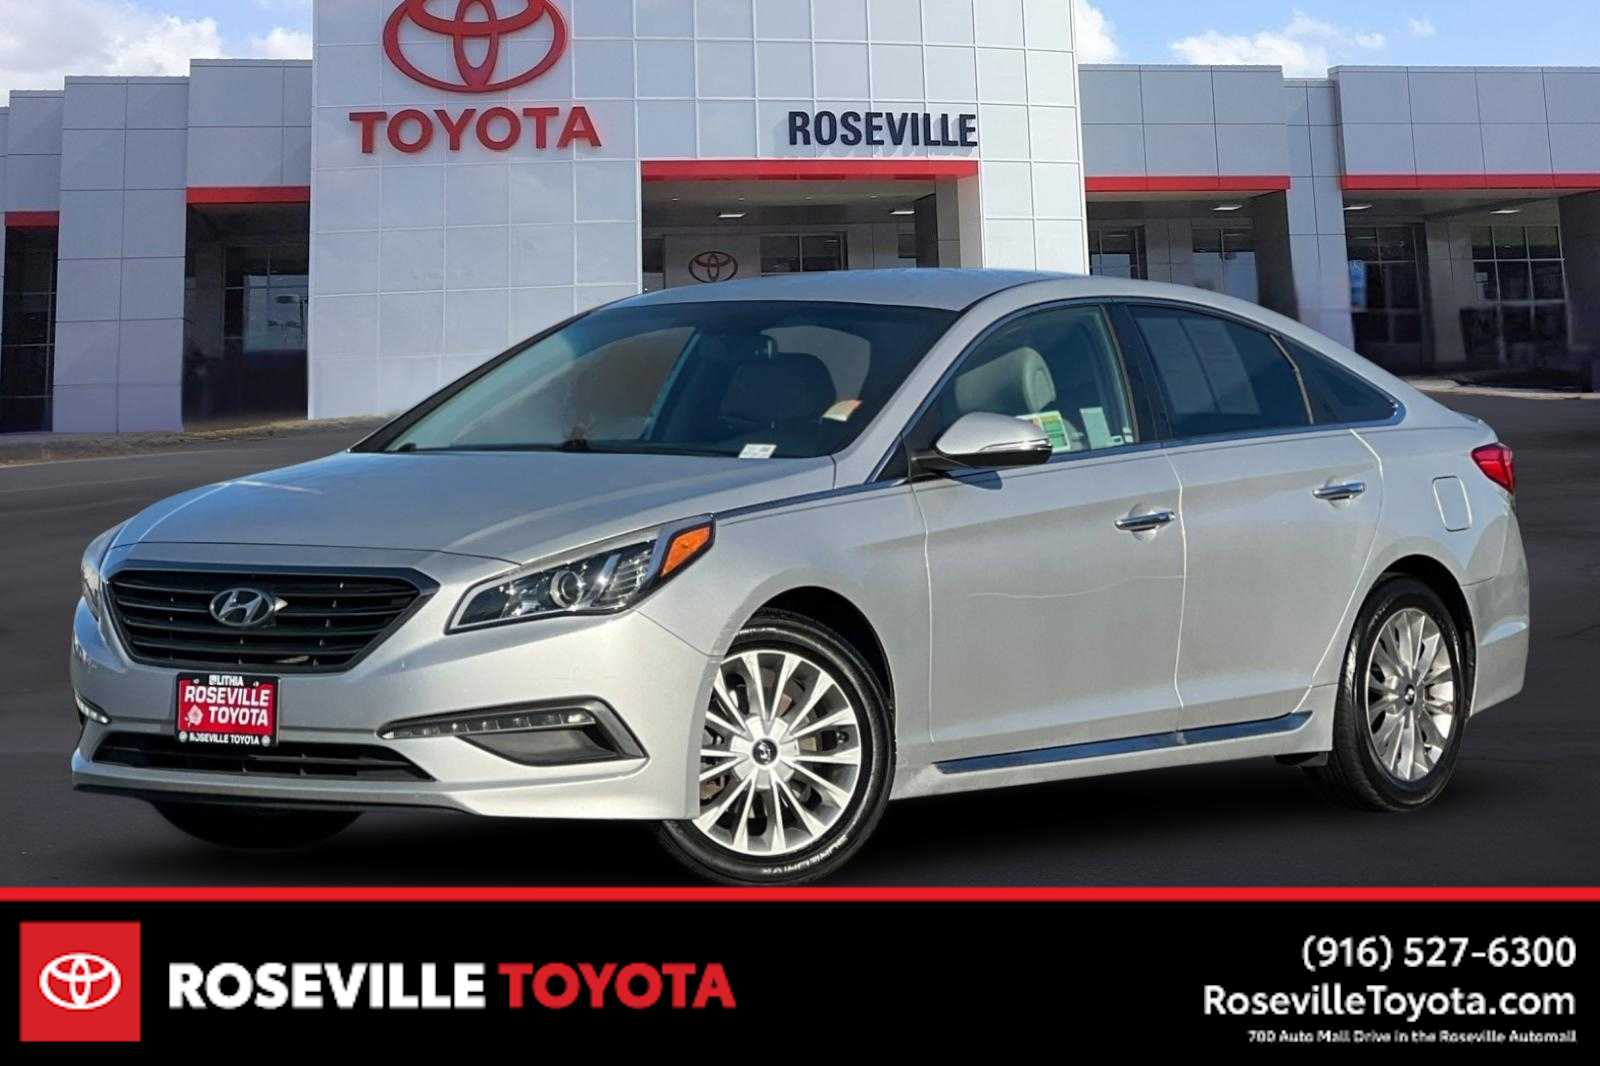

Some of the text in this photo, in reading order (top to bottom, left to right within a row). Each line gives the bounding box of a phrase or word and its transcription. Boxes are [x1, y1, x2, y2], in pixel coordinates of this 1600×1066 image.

[349, 106, 602, 154] TOYOTA
[788, 111, 978, 147] ROSEVILLE
[184, 686, 271, 707] ROSEVILLE
[208, 706, 269, 726] TOYOTA
